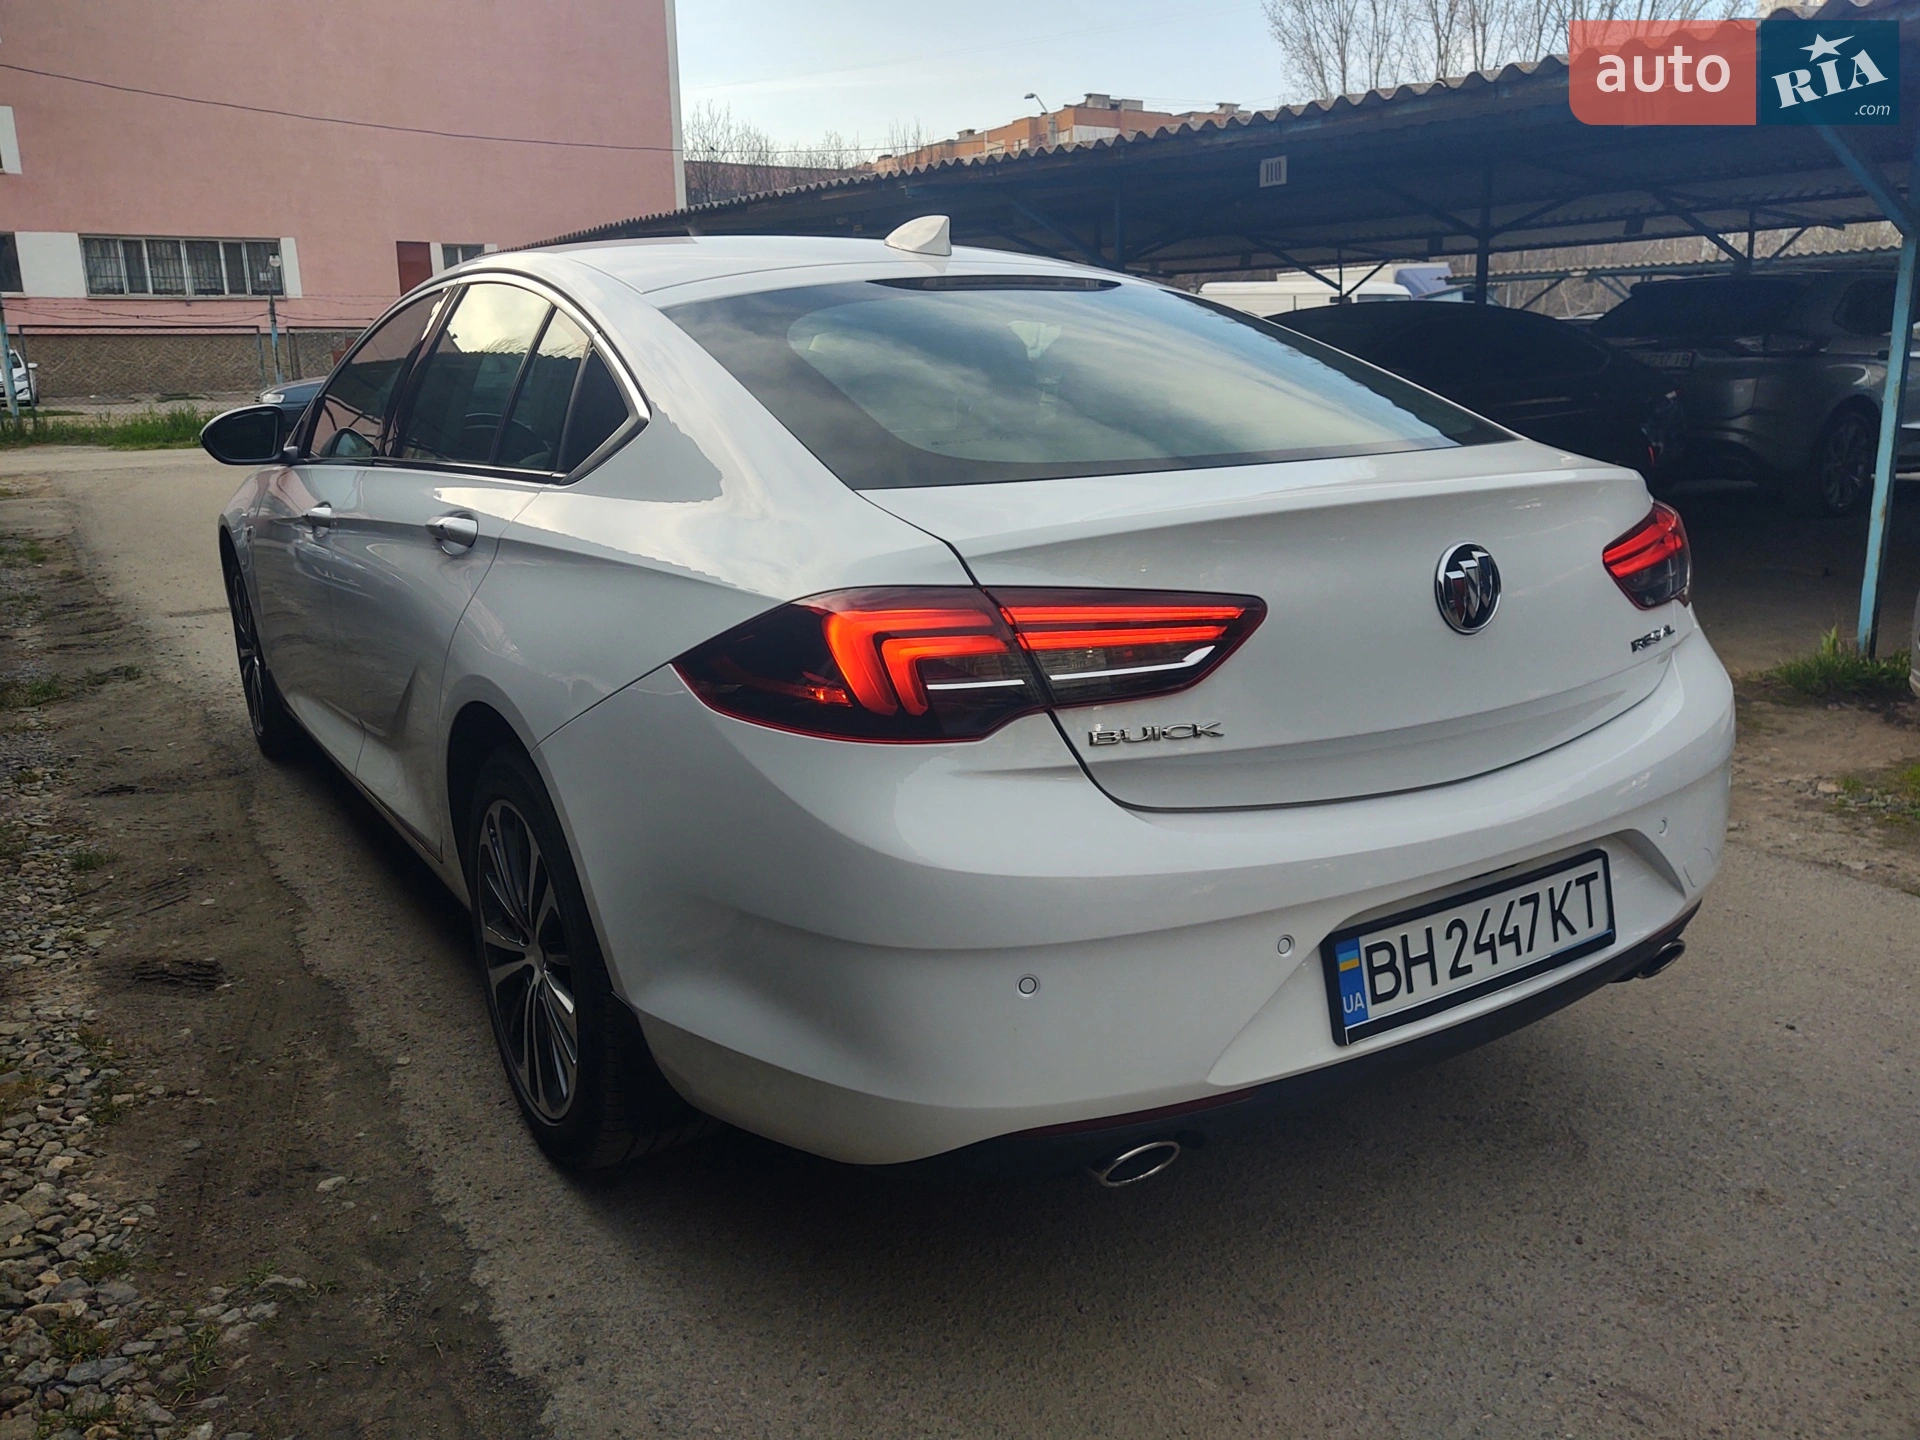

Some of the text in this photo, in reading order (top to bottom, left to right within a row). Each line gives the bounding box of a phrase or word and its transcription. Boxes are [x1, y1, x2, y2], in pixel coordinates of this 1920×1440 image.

[1265, 160, 1282, 183] 110
[1088, 722, 1225, 746] BUICK
[1364, 871, 1599, 1006] BH 2447 KT
[1342, 991, 1366, 1015] UA
